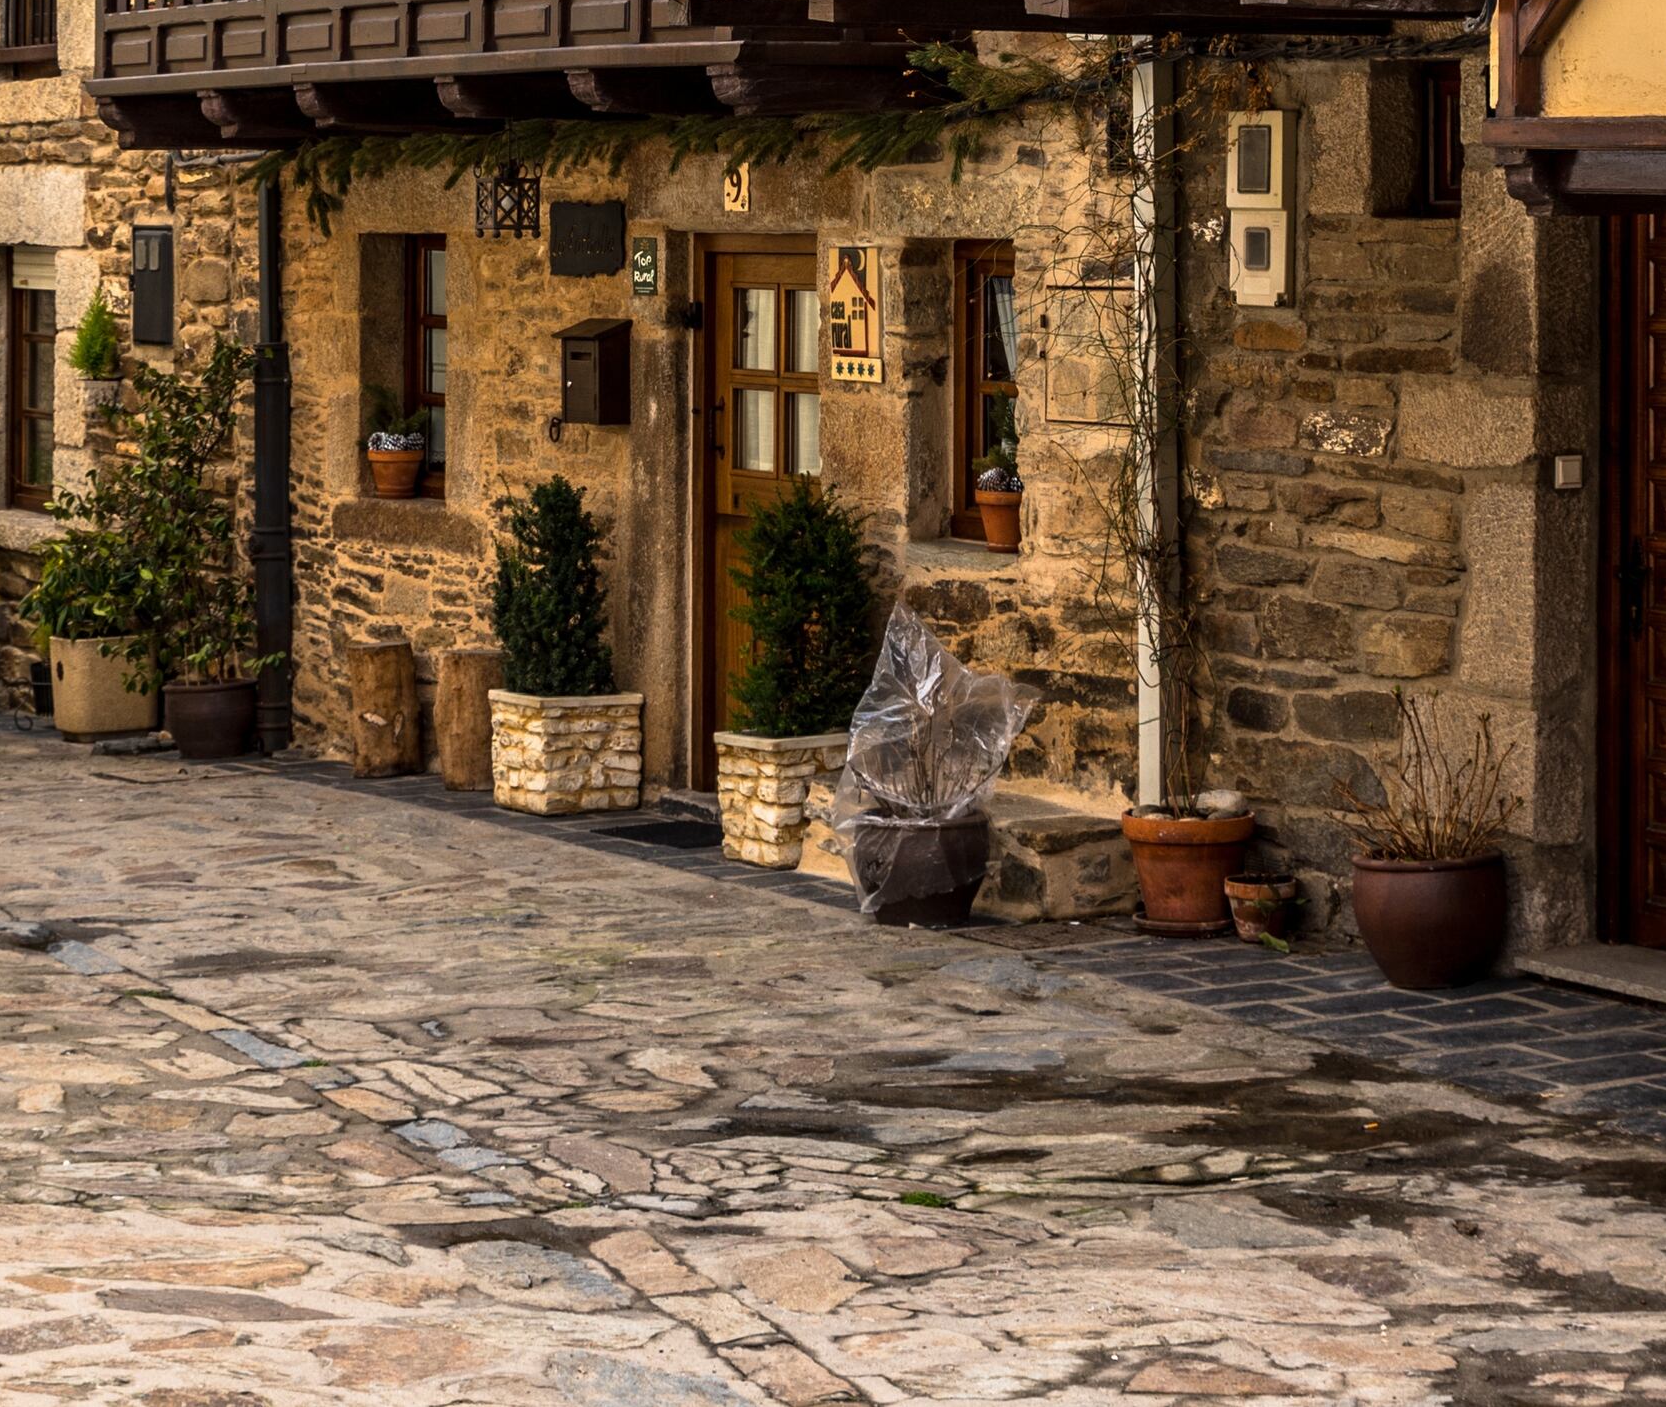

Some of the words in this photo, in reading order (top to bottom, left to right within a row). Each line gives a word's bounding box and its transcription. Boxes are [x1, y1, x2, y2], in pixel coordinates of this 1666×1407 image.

[730, 167, 742, 203] 9
[634, 269, 654, 284] Rural
[831, 301, 845, 320] casa
[831, 314, 852, 349] rural
